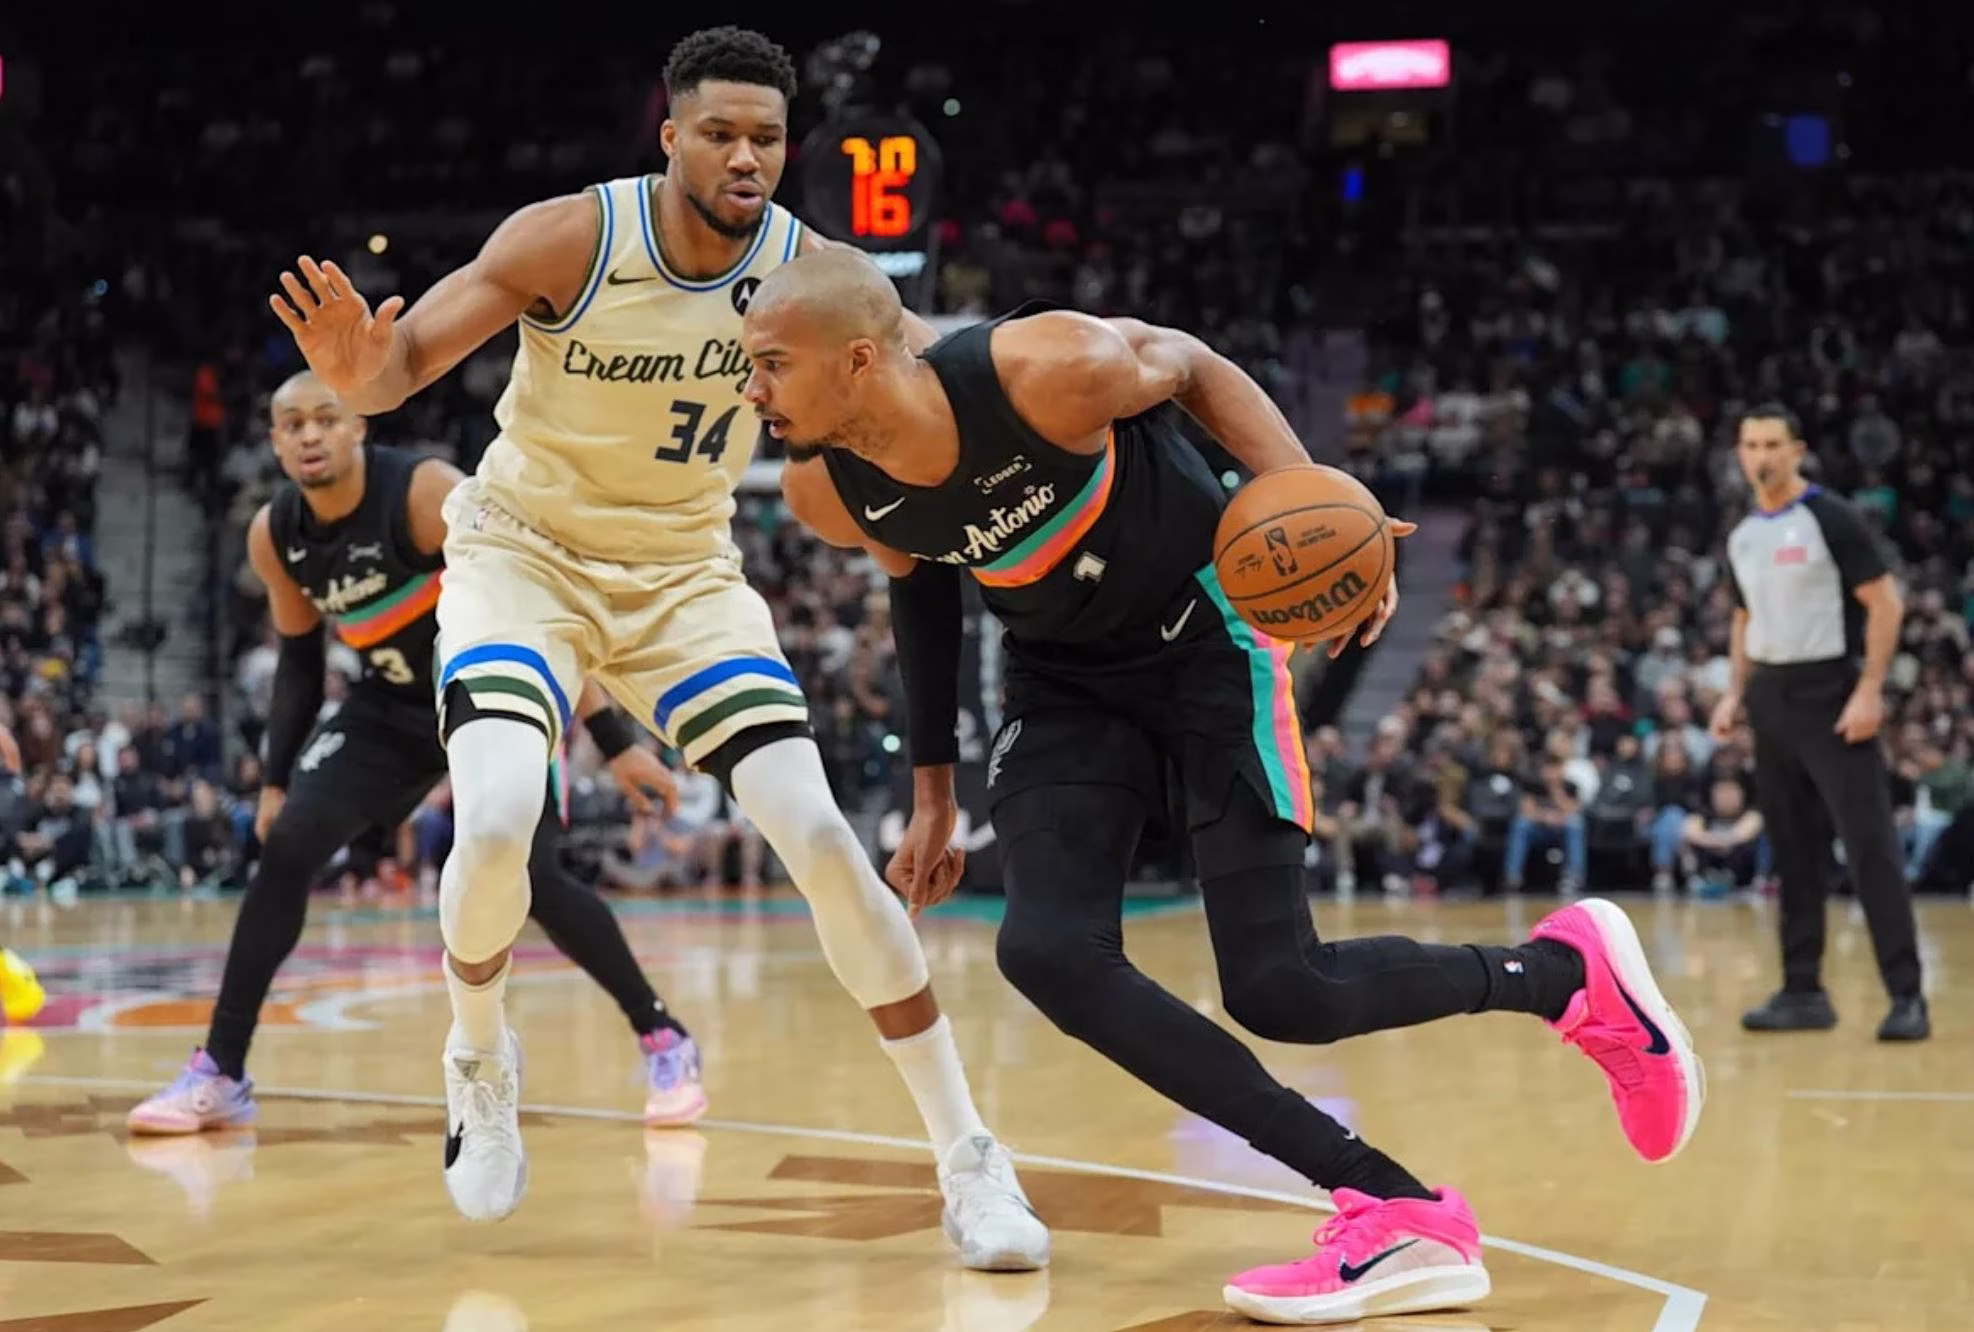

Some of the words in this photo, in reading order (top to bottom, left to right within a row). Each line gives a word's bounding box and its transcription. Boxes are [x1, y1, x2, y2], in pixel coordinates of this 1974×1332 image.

[852, 171, 912, 237] 16
[563, 338, 685, 383] Cream
[655, 399, 741, 464] 34
[962, 482, 1056, 560] Antonio
[1251, 570, 1368, 625] Wilson
[369, 647, 415, 685] 3
